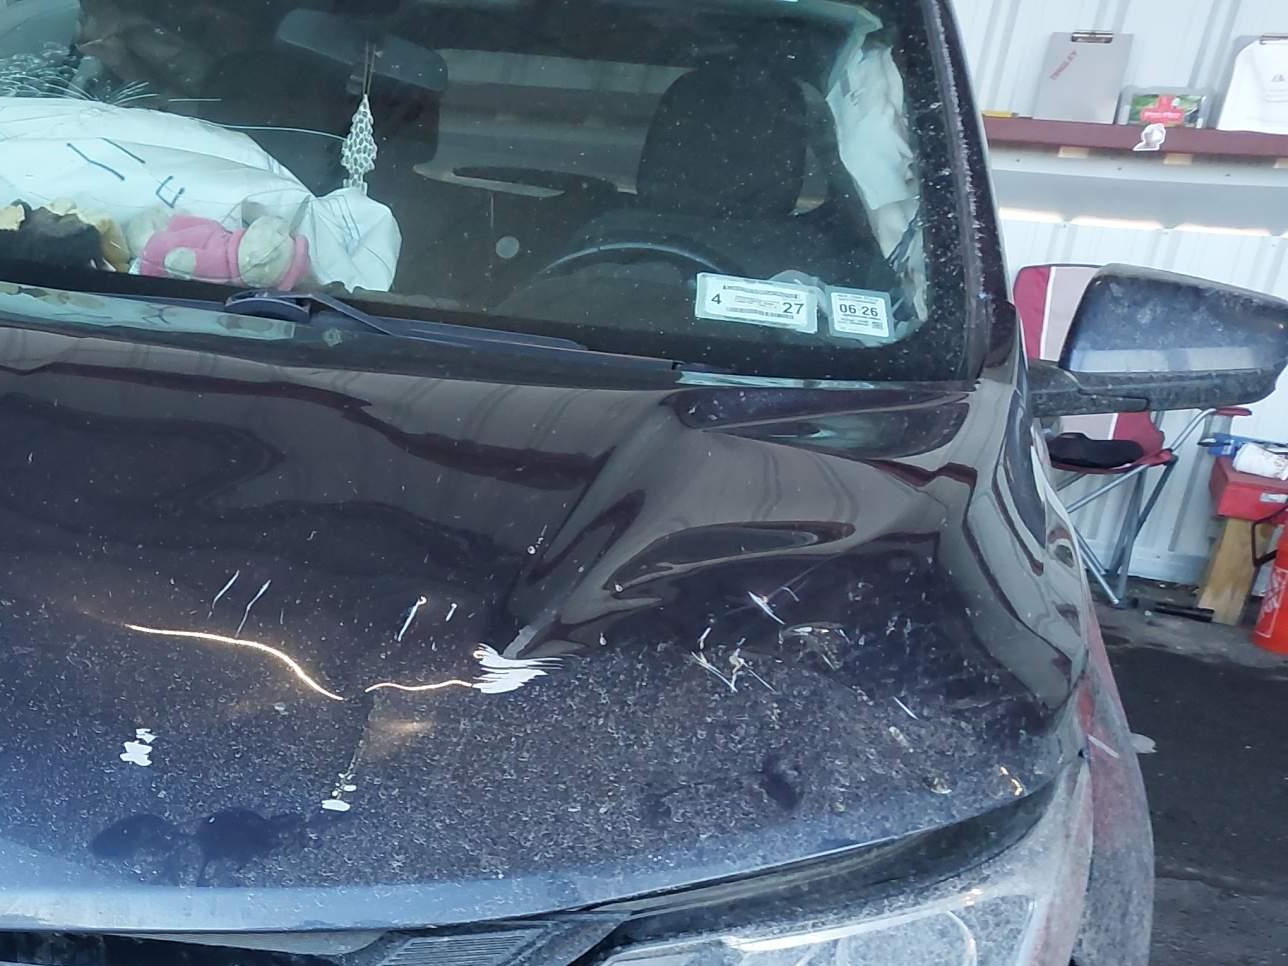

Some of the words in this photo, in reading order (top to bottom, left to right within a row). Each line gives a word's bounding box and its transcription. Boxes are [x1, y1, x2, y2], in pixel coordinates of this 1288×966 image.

[710, 293, 722, 305] 4
[782, 301, 805, 315] 27
[839, 303, 857, 315] 06
[861, 305, 879, 317] 26
